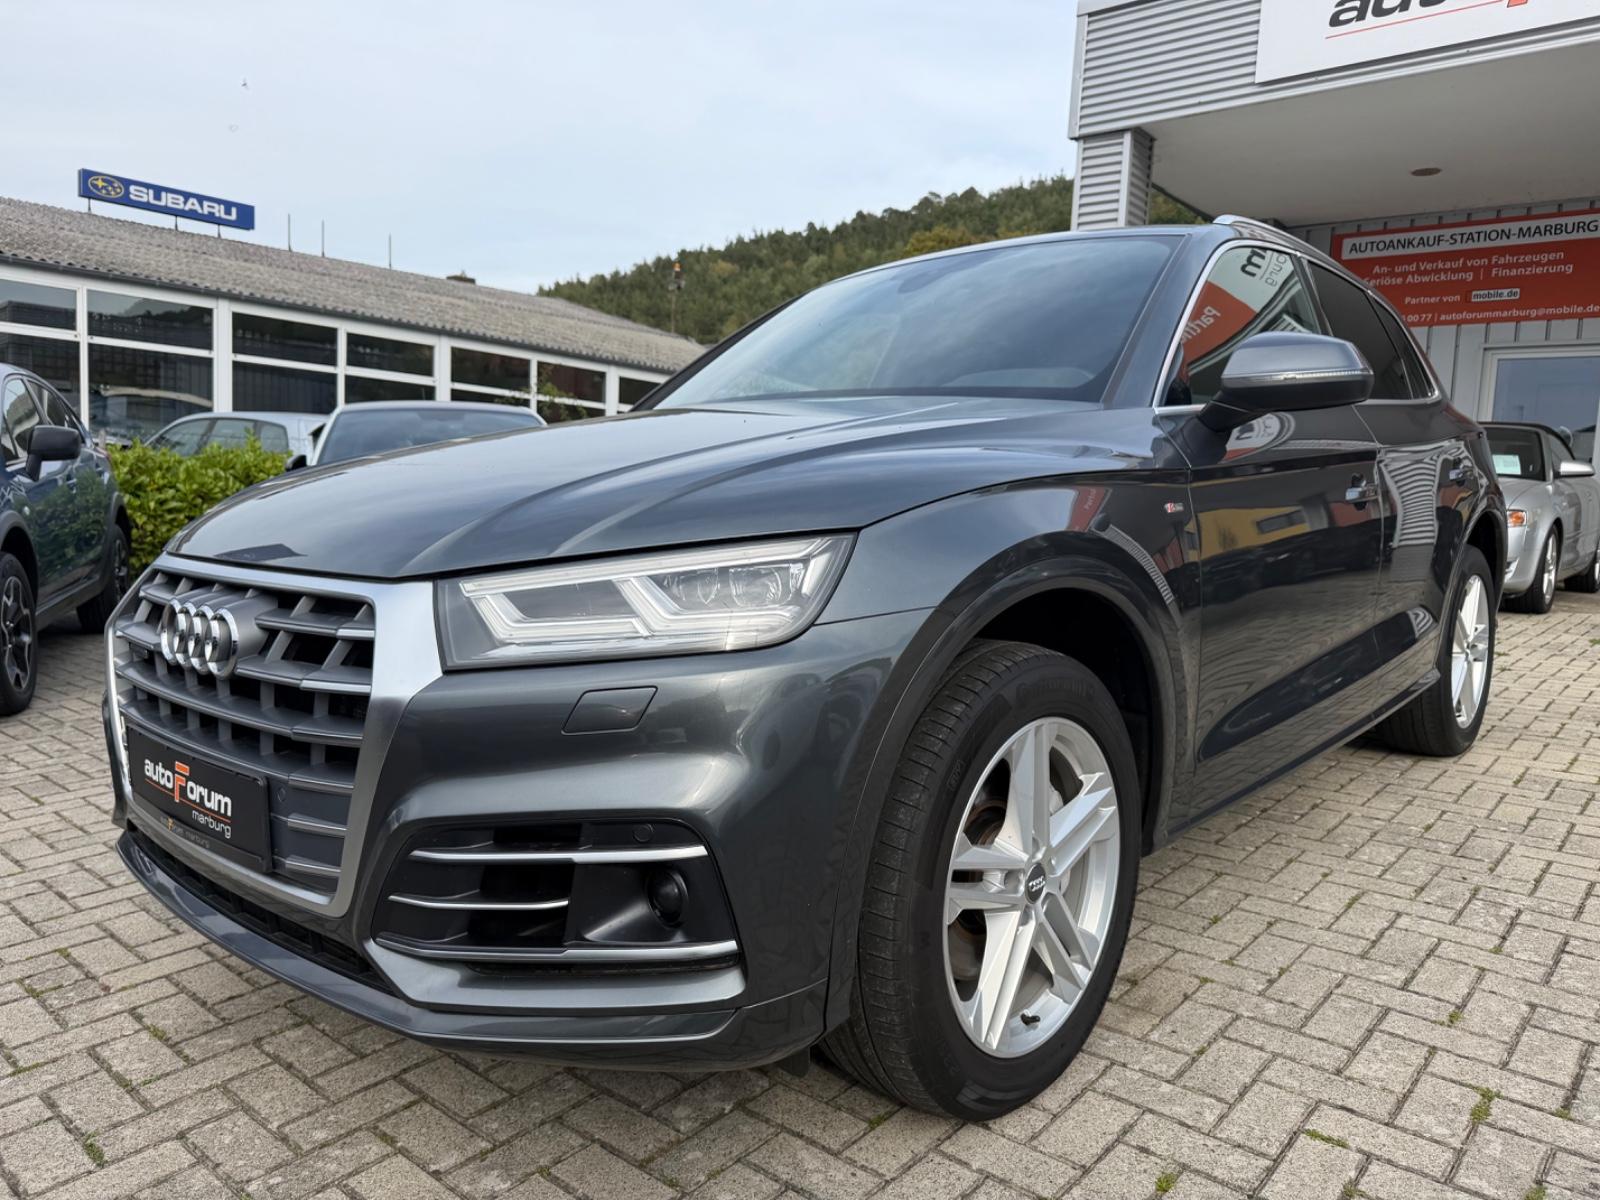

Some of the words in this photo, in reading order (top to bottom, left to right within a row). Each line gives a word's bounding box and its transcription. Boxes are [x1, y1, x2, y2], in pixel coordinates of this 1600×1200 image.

[129, 185, 237, 221] SUBARU
[1349, 220, 1599, 254] AUTOANKAUF-STATION-MARBURG
[1372, 265, 1392, 274] An-
[1394, 262, 1417, 273] und
[1419, 258, 1464, 271] Verkauf
[1466, 258, 1488, 267] von
[1491, 251, 1564, 265] Fahrzeugen
[1405, 271, 1473, 284] Abwicklung
[1491, 263, 1574, 278] Finanzierung
[1405, 295, 1441, 305] Partner
[1442, 295, 1460, 303] von
[1472, 288, 1519, 300] mobile.de
[1440, 304, 1600, 321] autoforummarburg@mobile.de
[191, 809, 232, 839] marburg
